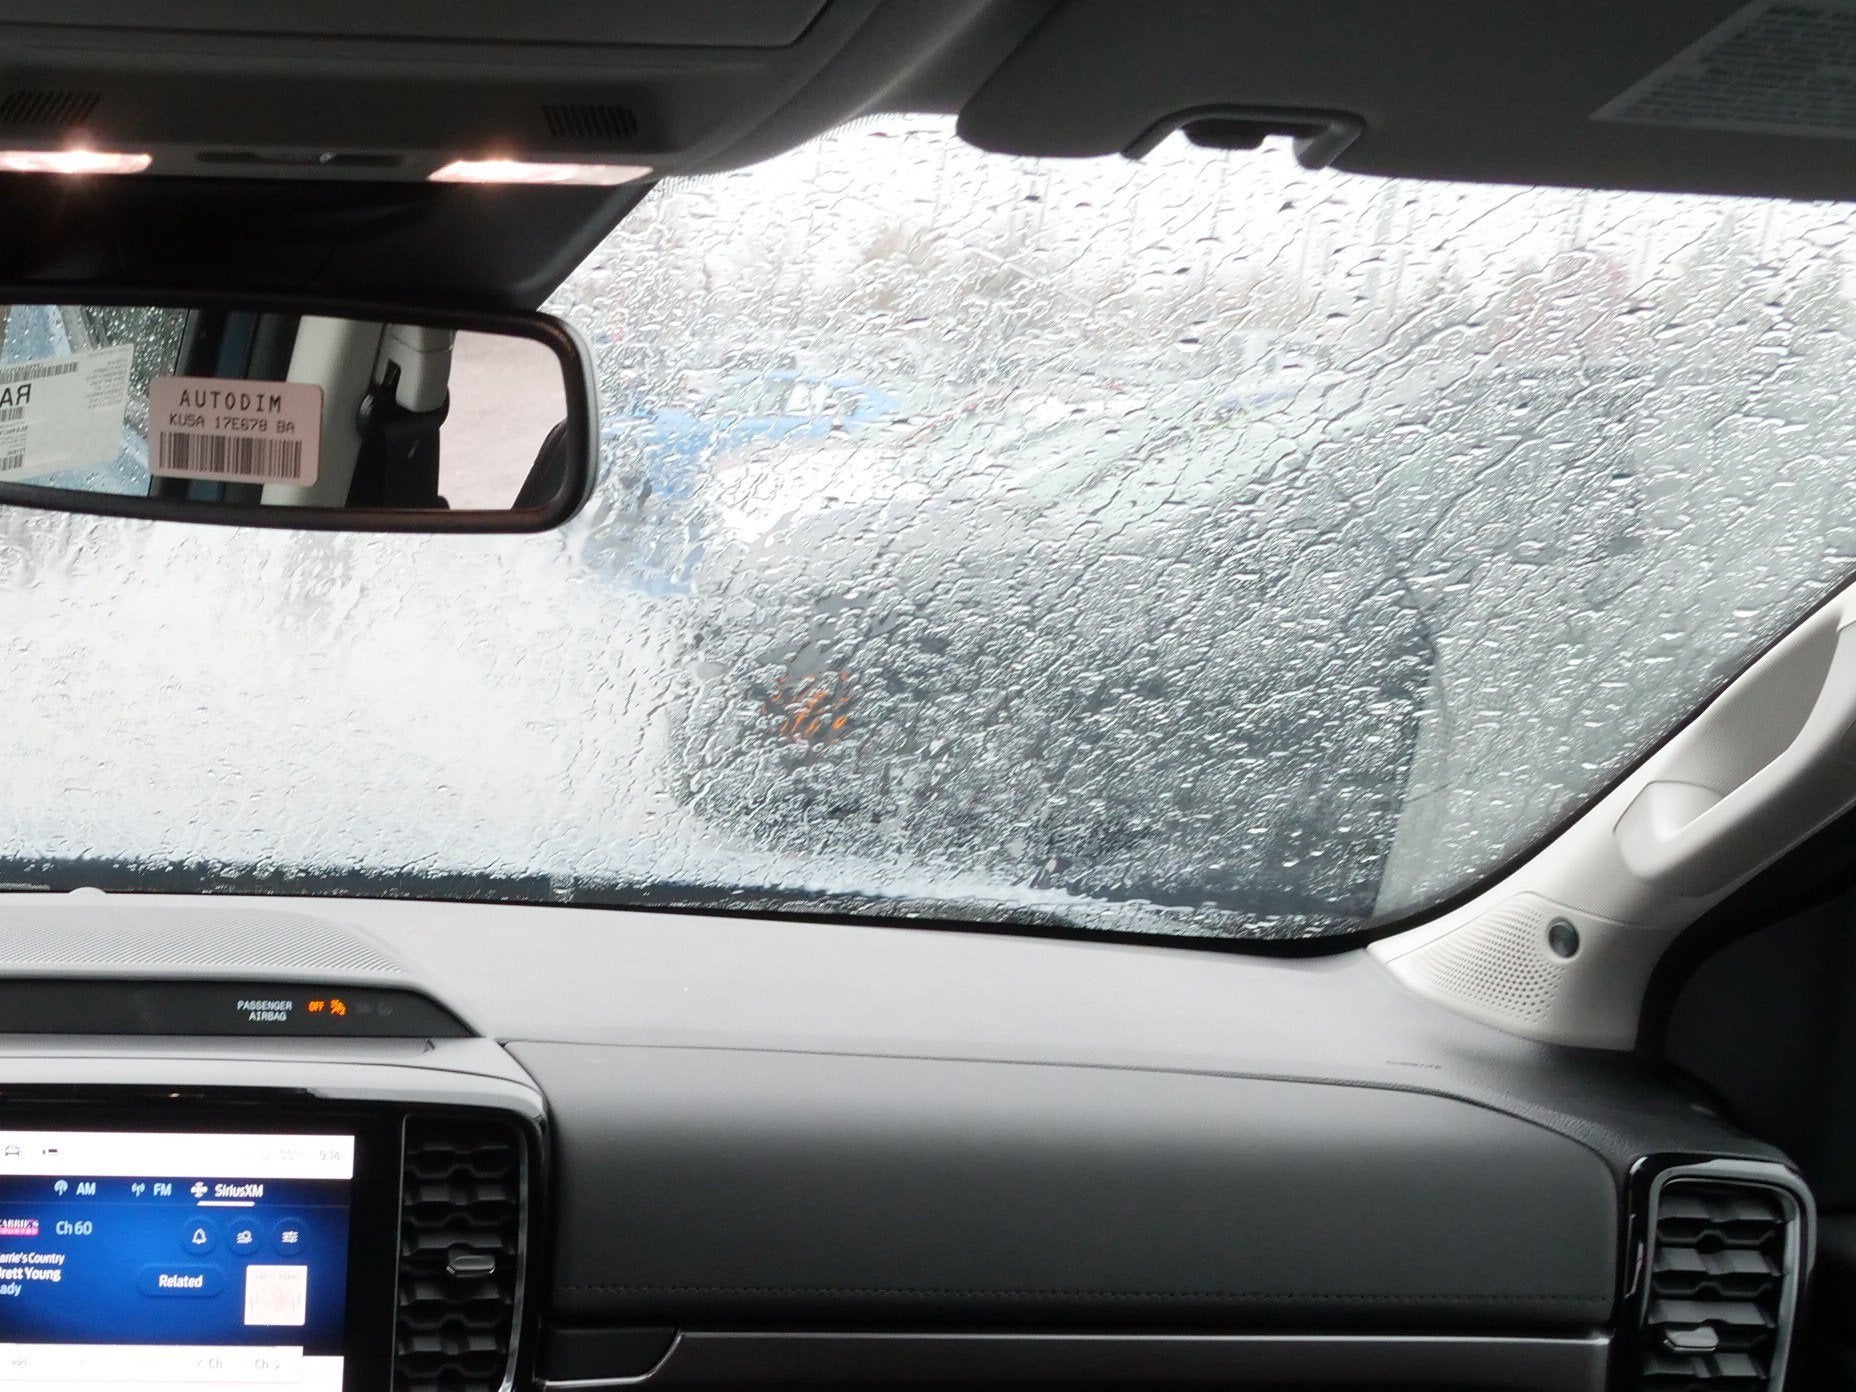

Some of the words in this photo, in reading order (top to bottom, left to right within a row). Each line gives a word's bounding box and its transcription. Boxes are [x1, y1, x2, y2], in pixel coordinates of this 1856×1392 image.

[179, 389, 281, 413] AUTODIM
[237, 1000, 293, 1011] PASSENGER
[308, 1001, 325, 1012] OFF
[248, 1011, 287, 1022] AIRBAG
[76, 1183, 96, 1196] AM
[153, 1183, 172, 1196] FM
[214, 1183, 264, 1198] SiriusXM
[55, 1221, 73, 1236] Ch
[74, 1221, 93, 1236] 60
[28, 1252, 65, 1267] Country
[23, 1266, 61, 1283] Young
[158, 1274, 203, 1288] Related
